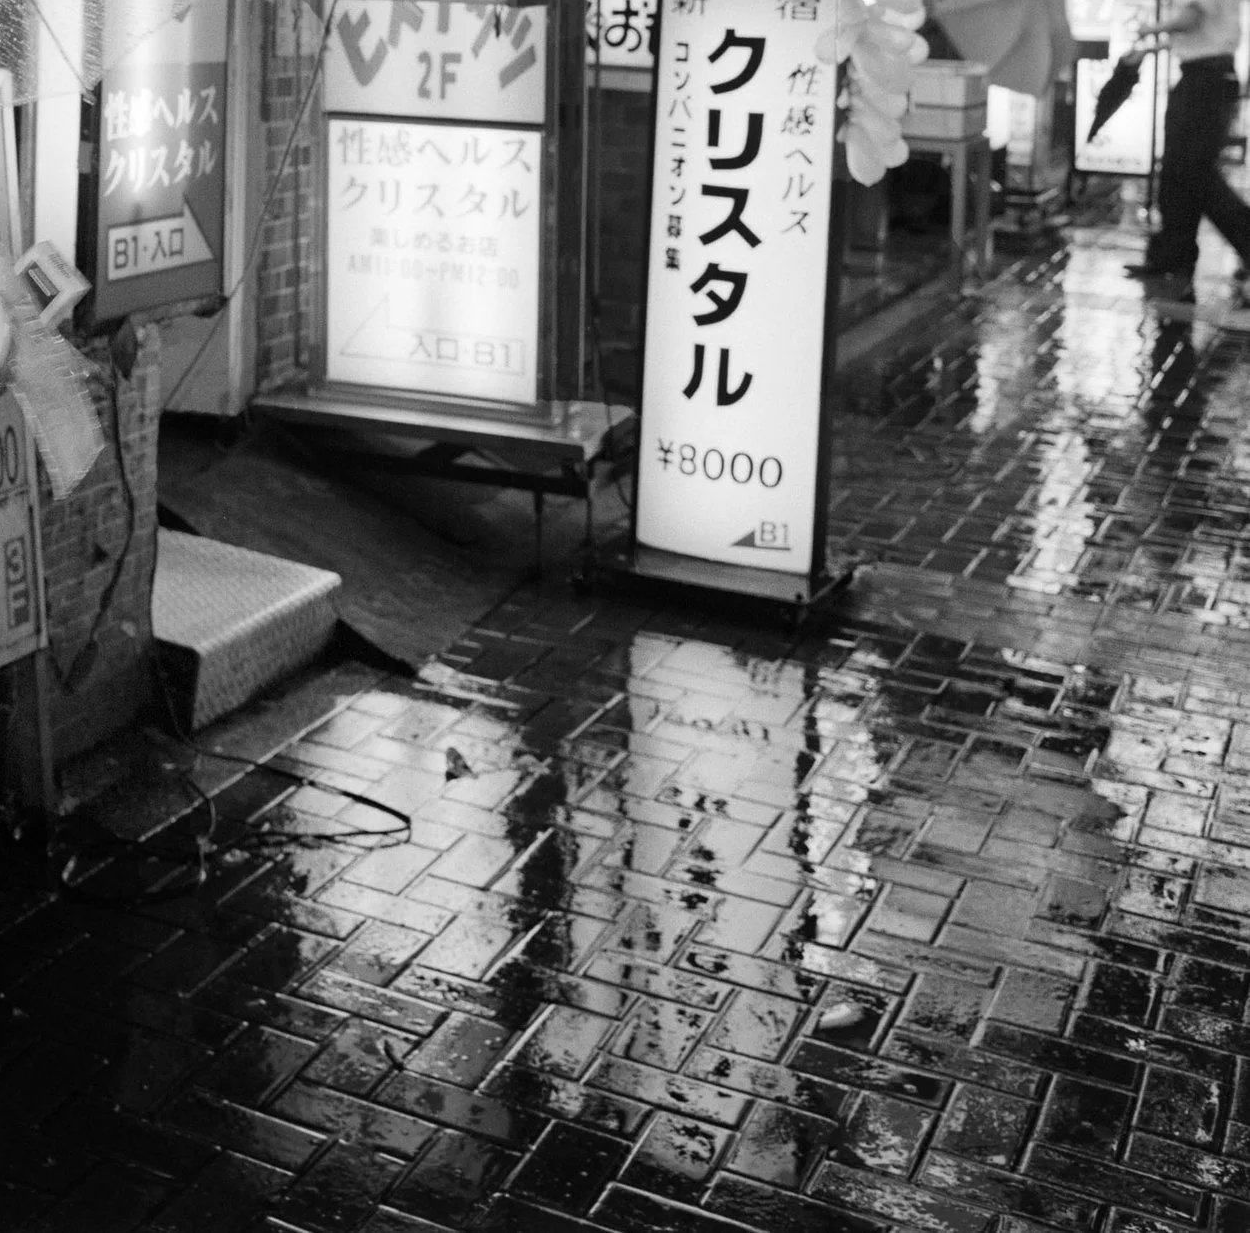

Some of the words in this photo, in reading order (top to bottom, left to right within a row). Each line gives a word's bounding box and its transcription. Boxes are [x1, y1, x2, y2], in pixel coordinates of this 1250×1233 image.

[416, 49, 463, 100] 2F
[103, 137, 217, 198] クリスタル
[337, 124, 533, 174] 性感ヘルス
[338, 175, 532, 221] クリスタル
[681, 27, 767, 408] クリスタル
[658, 437, 784, 488] ¥8000
[758, 521, 791, 544] B1
